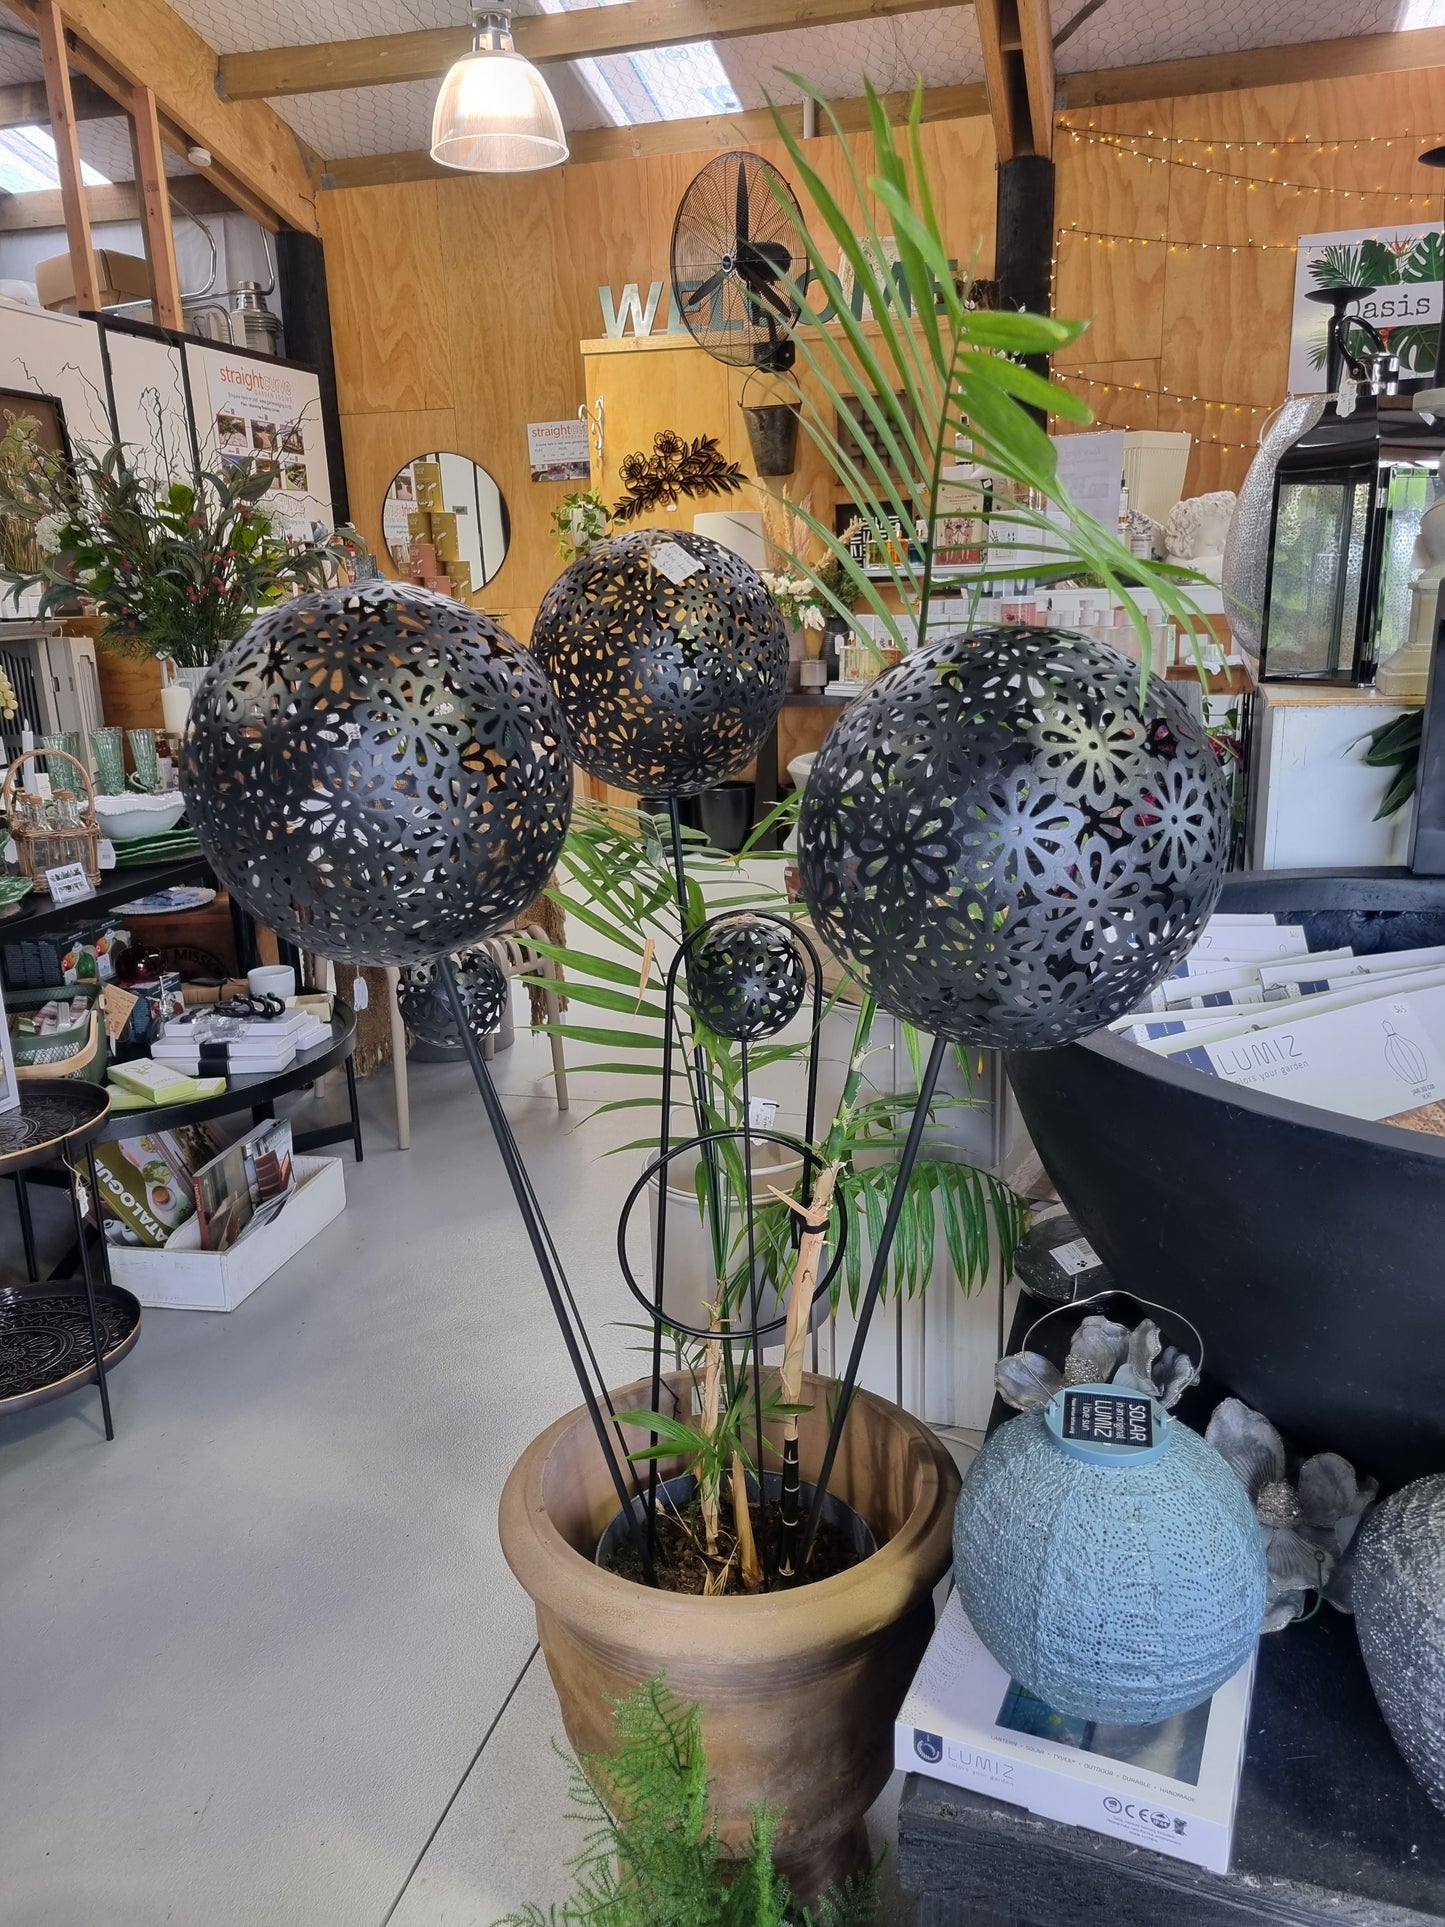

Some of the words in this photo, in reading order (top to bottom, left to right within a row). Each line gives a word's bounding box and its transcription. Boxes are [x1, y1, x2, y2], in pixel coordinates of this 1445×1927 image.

[1217, 1035, 1303, 1075] LUMIZ
[1260, 1068, 1278, 1081] your
[1281, 1060, 1309, 1076] garden
[1081, 1419, 1090, 1431] sun
[1082, 1405, 1092, 1419] love
[1094, 1400, 1113, 1438] LUMIZ
[1113, 1415, 1127, 1439] original
[1128, 1404, 1147, 1441] SOLAR
[948, 1746, 1014, 1780] LUMIZ
[990, 1735, 1018, 1747] LANTERN
[1025, 1744, 1045, 1755] SOLAR
[1084, 1763, 1114, 1777] OUTDOOR
[1122, 1775, 1151, 1788] DURABLE
[1159, 1787, 1195, 1802] HANDMADE
